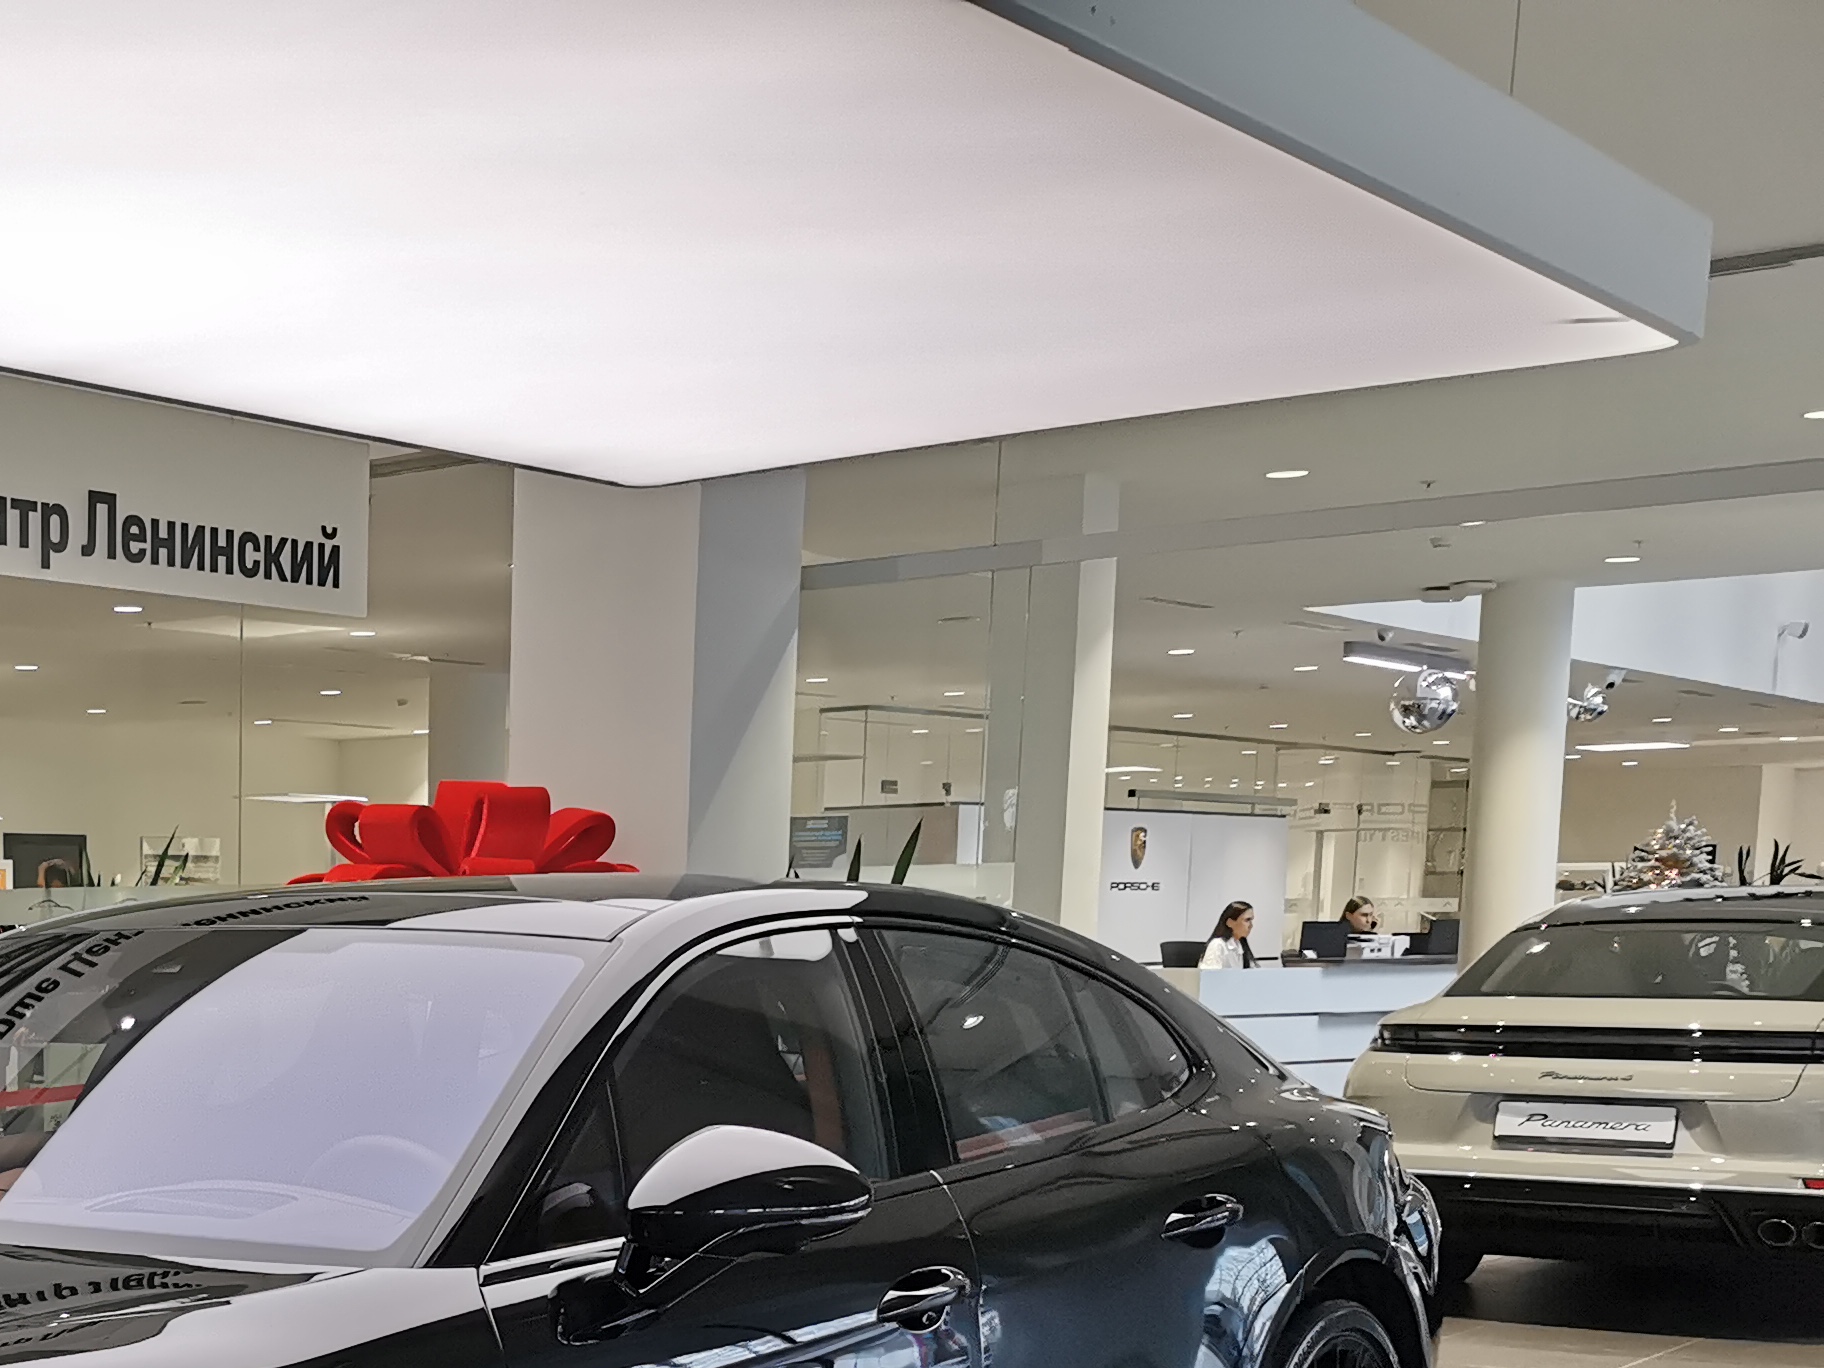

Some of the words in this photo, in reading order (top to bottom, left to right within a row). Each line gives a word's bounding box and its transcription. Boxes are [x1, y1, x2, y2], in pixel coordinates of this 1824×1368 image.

[81, 489, 341, 590] Ленинский
[1110, 881, 1161, 892] PORSCHE
[1517, 1113, 1652, 1132] Panamera
